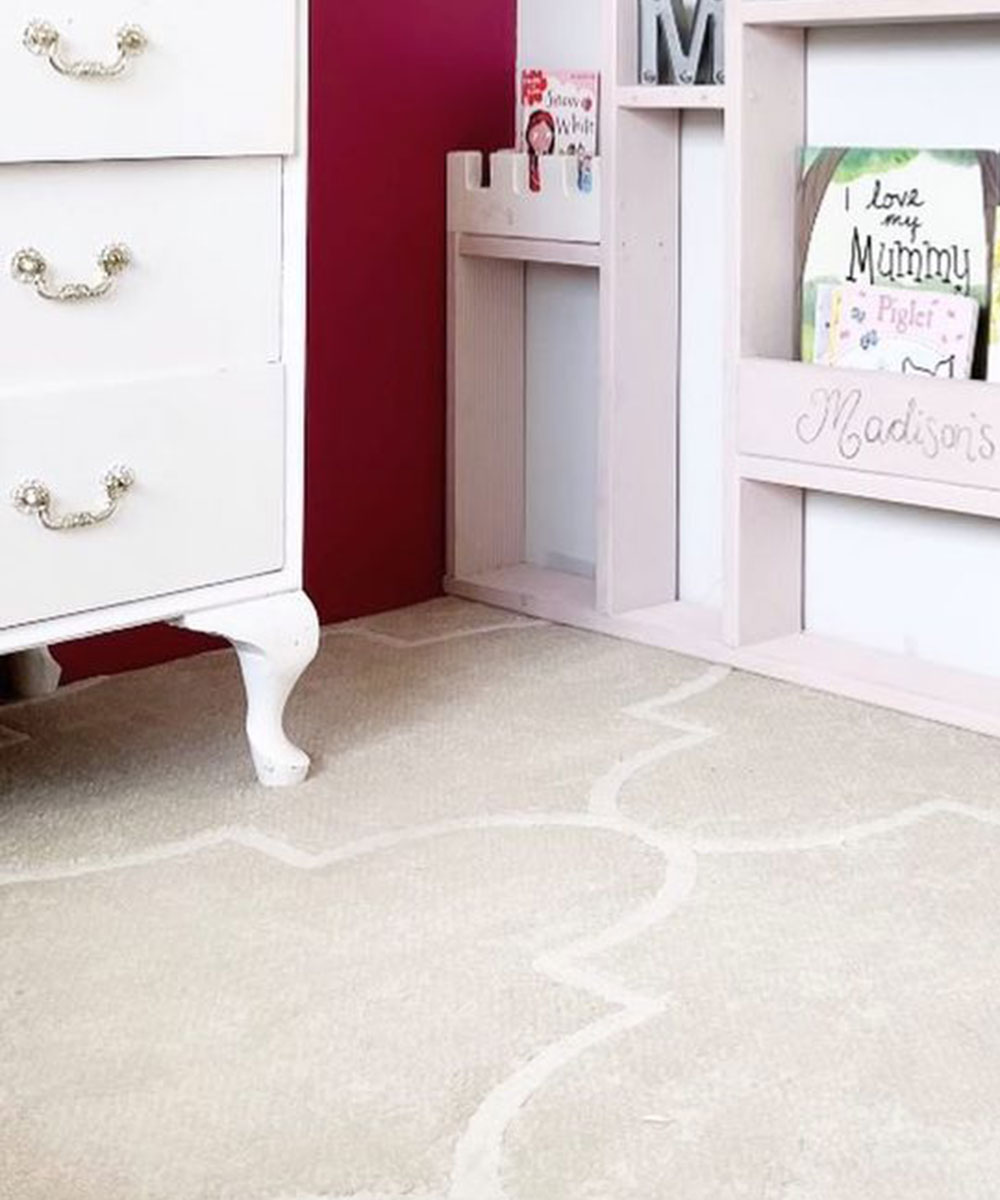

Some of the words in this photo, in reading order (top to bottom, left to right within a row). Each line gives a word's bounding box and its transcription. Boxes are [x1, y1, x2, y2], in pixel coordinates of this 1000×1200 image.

[844, 186, 851, 212] I
[865, 178, 926, 210] love
[880, 213, 922, 244] my
[845, 225, 971, 297] Mummy
[877, 294, 934, 333] Piglet
[795, 387, 997, 462] Madison's
